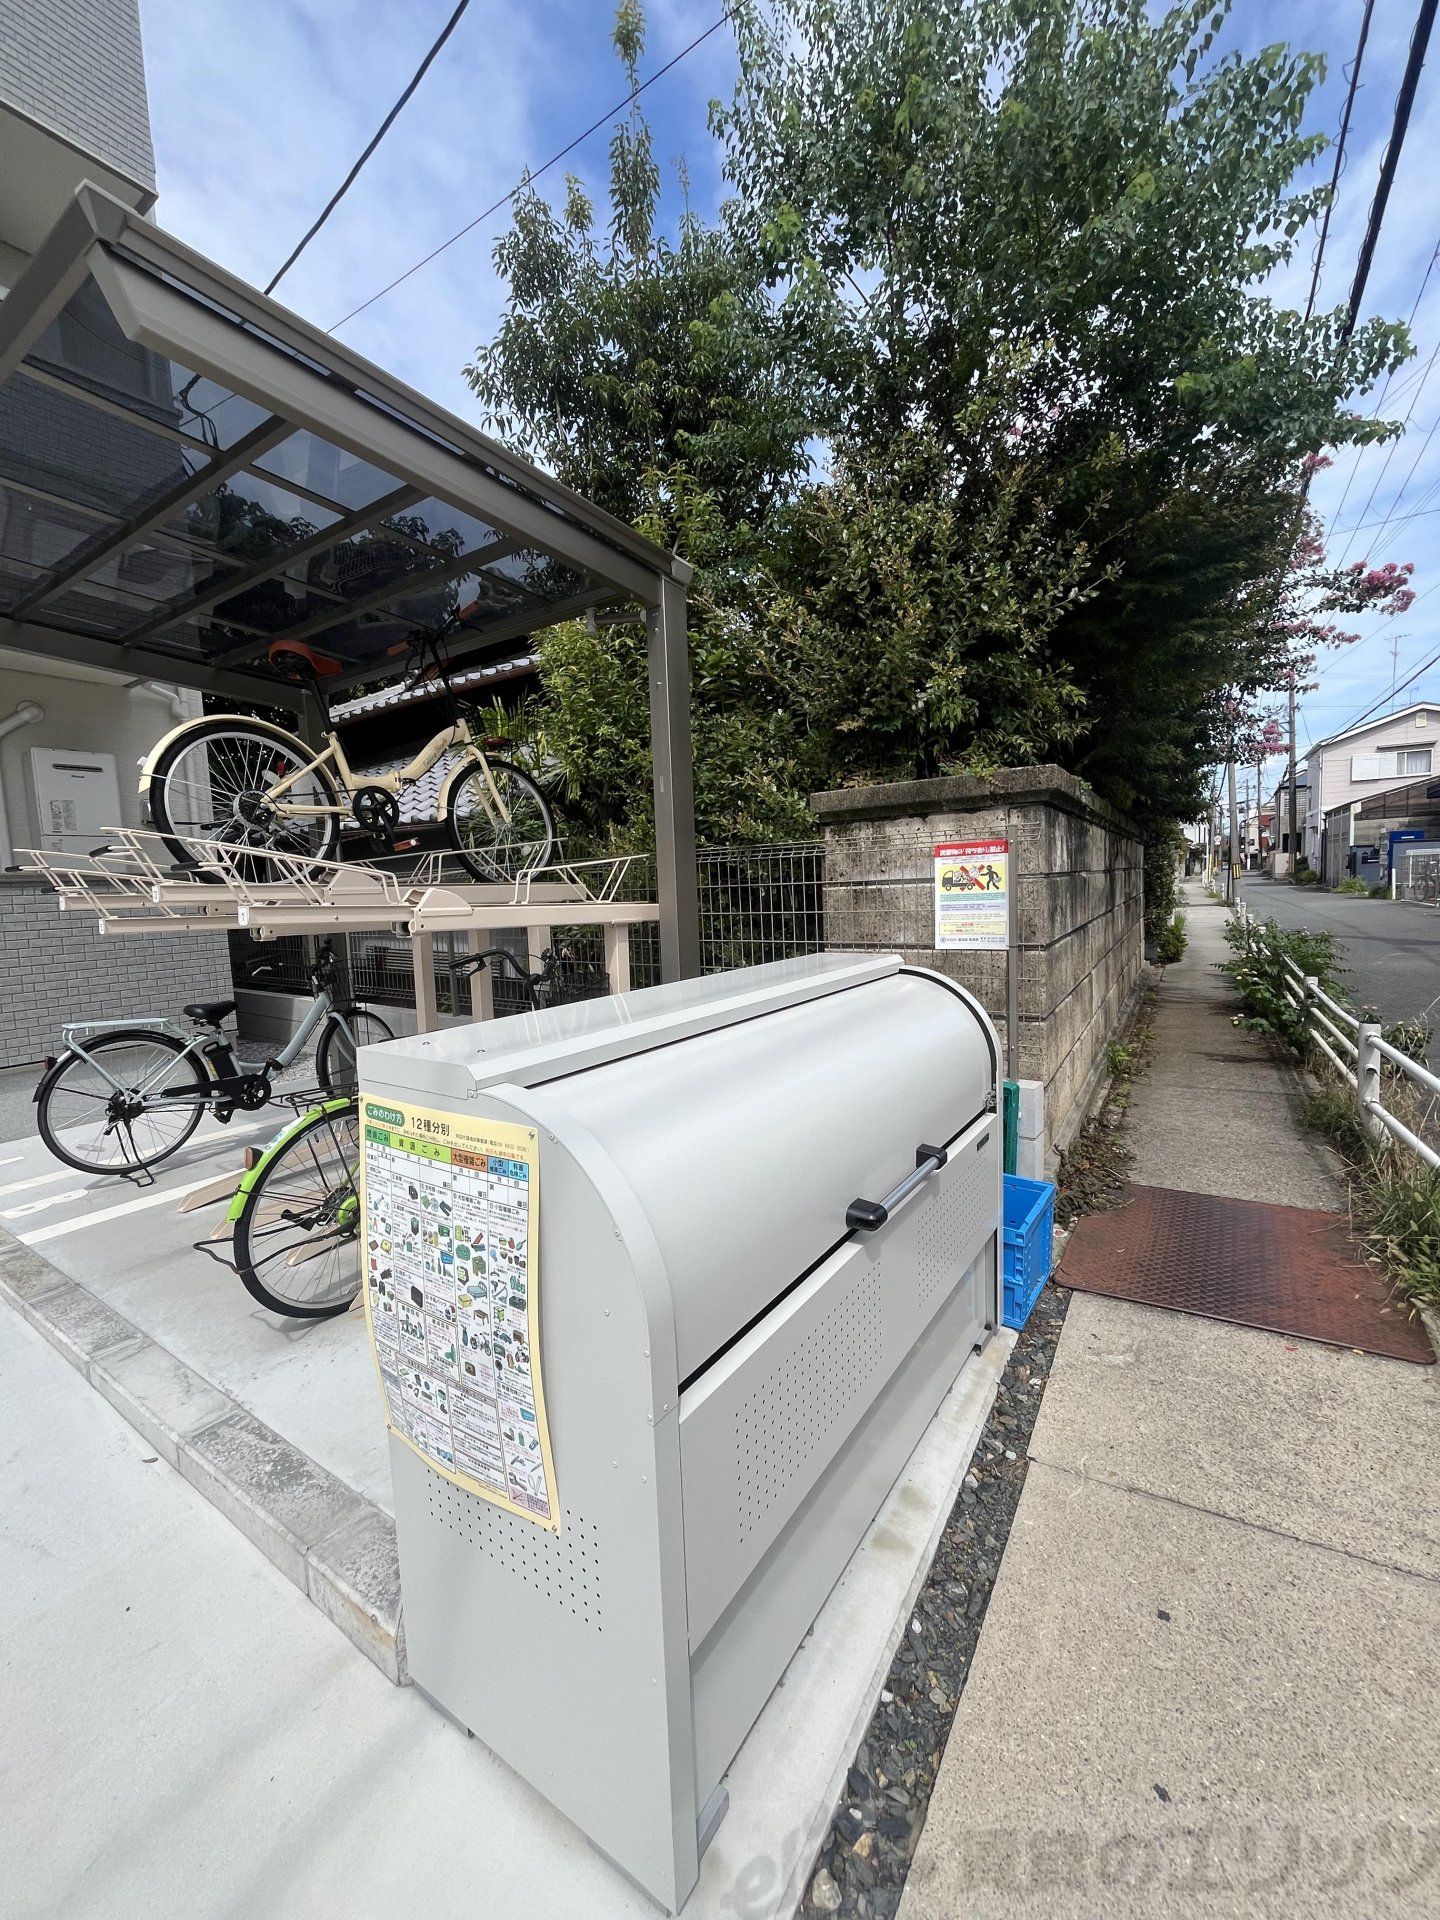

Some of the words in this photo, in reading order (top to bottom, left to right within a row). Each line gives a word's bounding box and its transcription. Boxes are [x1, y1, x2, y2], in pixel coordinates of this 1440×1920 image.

[367, 1106, 402, 1124] ごみのわけ方
[411, 1117, 450, 1136] 12種分別
[453, 1153, 487, 1168] 大型複雑ごみ
